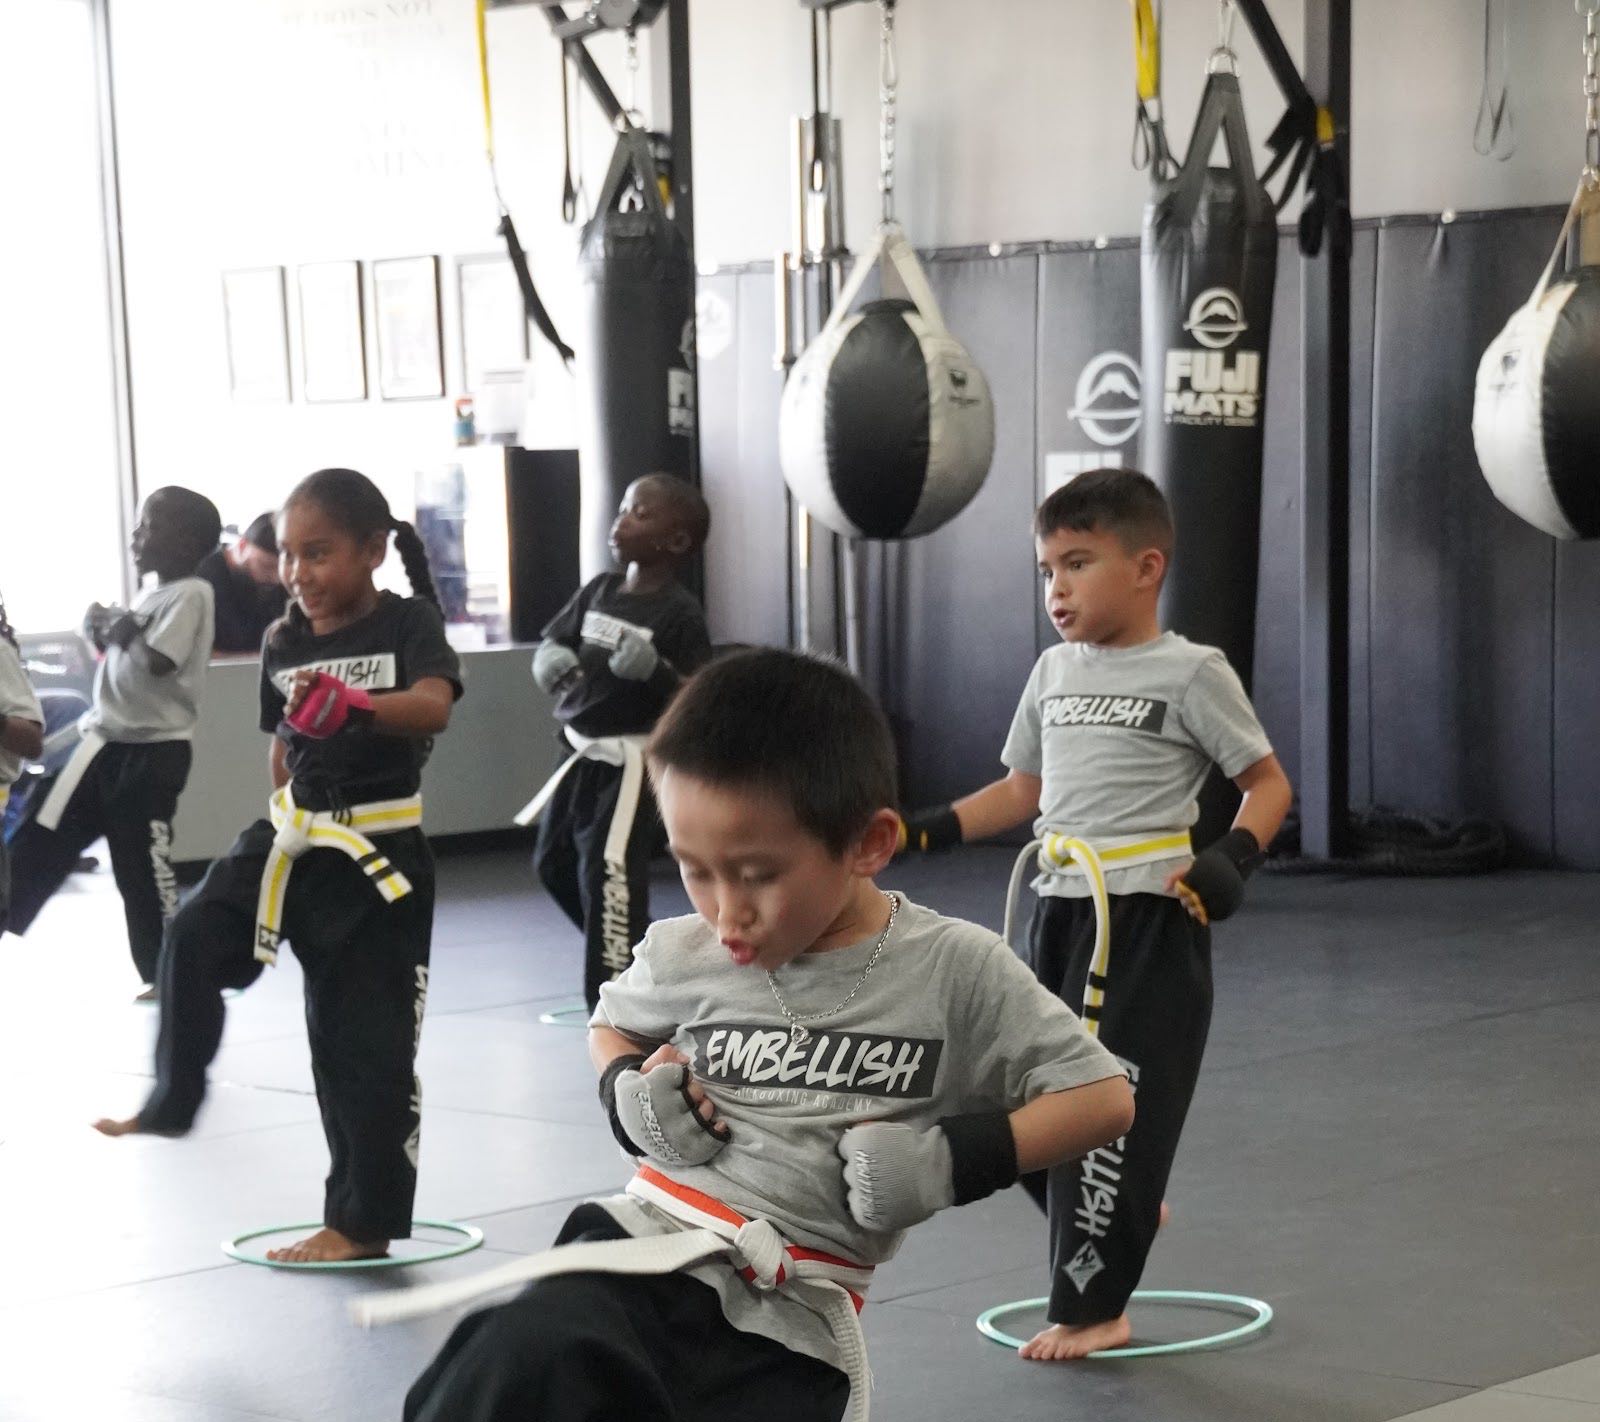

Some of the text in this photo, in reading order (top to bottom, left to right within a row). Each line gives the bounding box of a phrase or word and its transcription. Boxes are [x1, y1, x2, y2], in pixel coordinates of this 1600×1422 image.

[1165, 350, 1260, 392] FUJI
[1163, 391, 1258, 418] MATS
[1041, 696, 1153, 729] EMBELLISH
[707, 1028, 924, 1094] EMBELLISH
